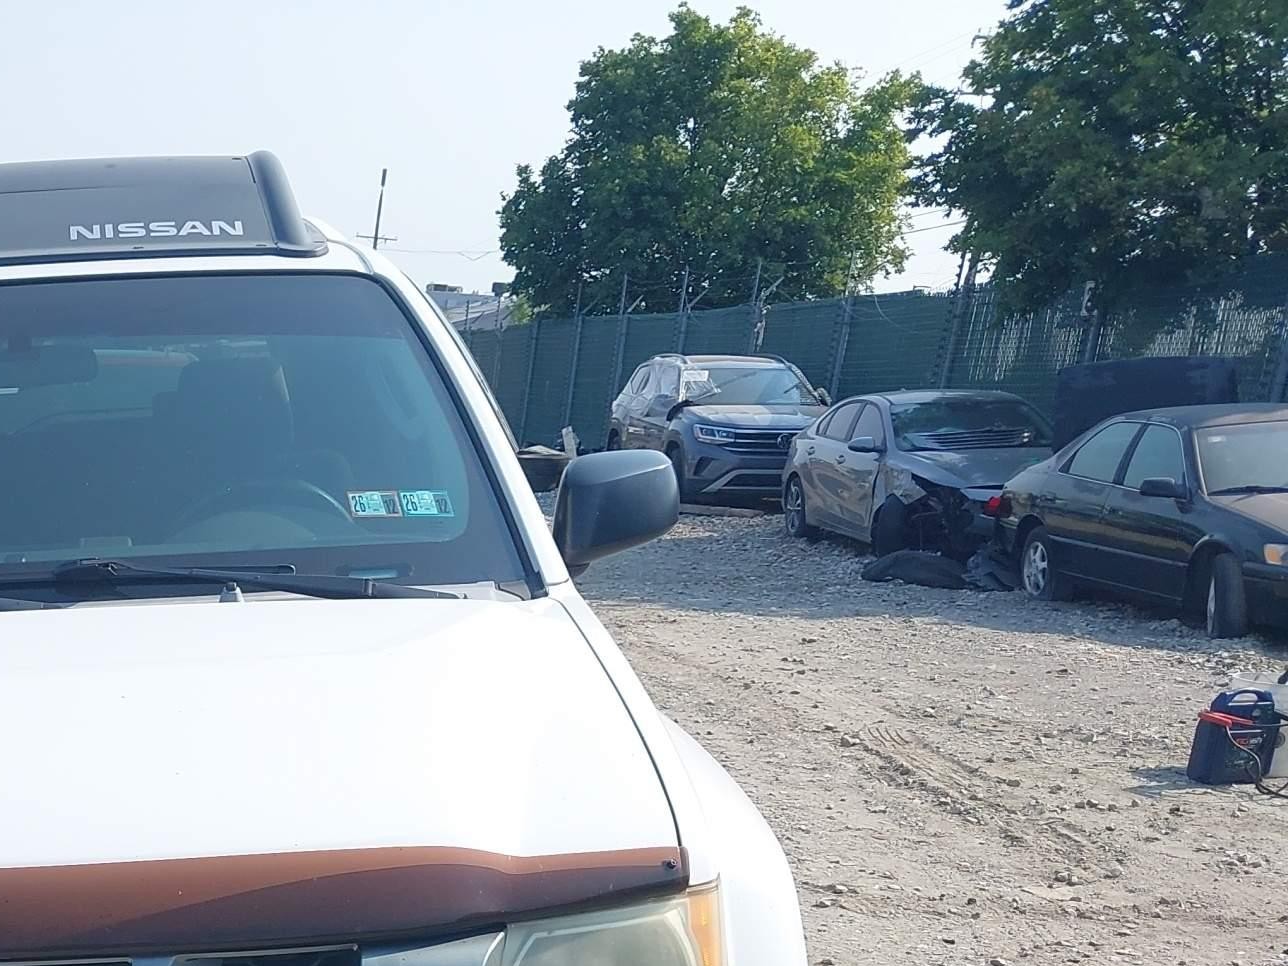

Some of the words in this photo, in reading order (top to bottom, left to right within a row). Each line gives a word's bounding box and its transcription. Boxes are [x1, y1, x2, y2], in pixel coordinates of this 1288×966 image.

[69, 220, 245, 241] NISSAN
[351, 495, 367, 512] 26
[402, 494, 418, 511] 26
